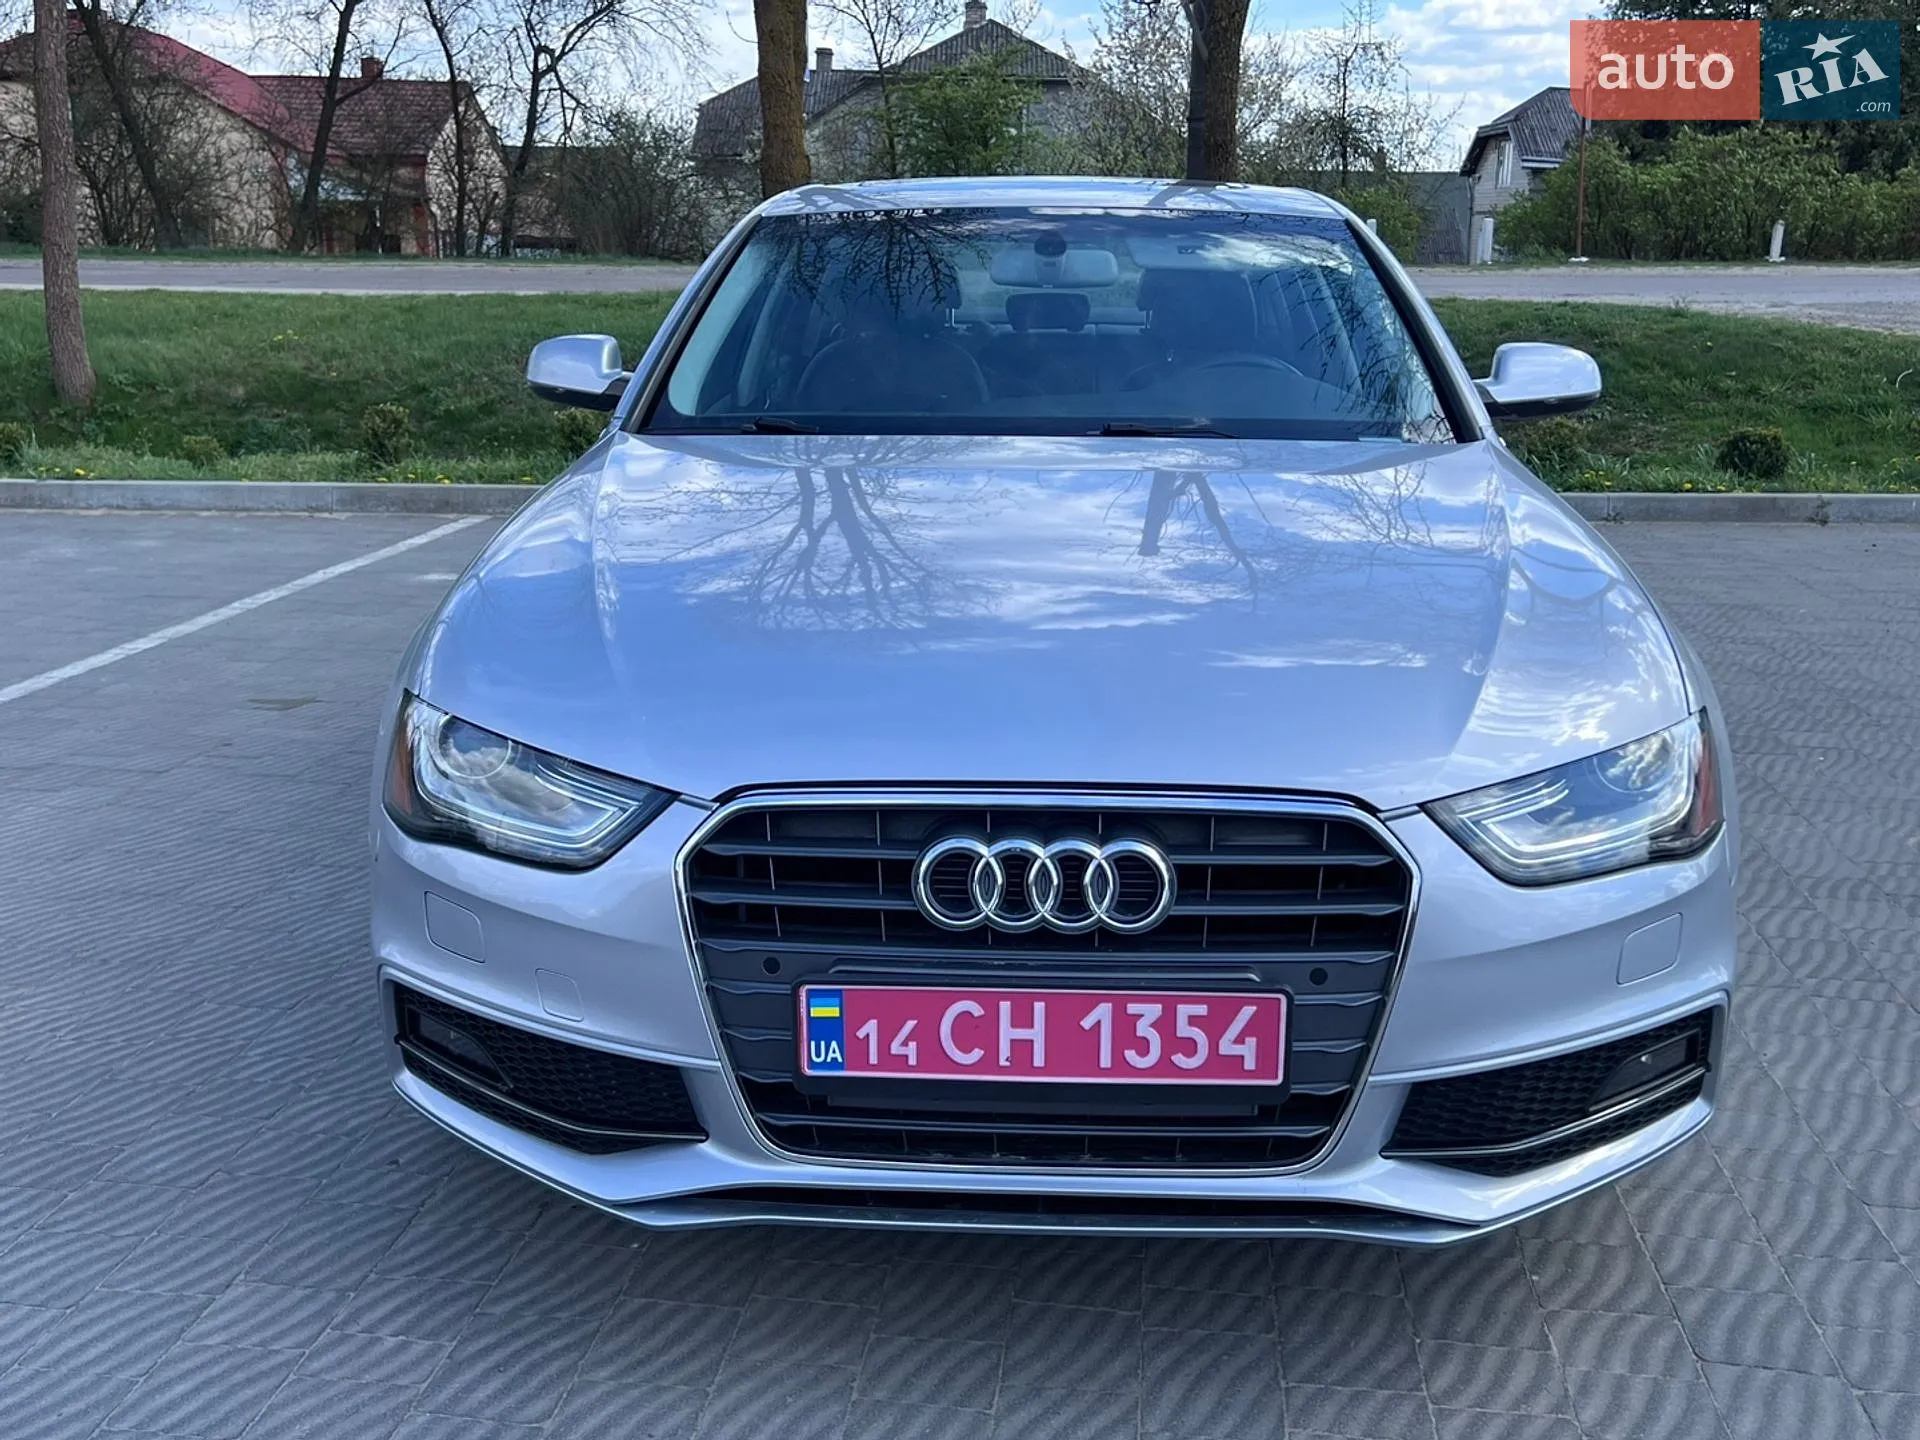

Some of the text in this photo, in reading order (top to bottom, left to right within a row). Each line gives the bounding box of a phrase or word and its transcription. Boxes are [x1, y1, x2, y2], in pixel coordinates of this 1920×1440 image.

[810, 1040, 843, 1063] UA
[855, 1000, 1258, 1070] 14 CH 1354
